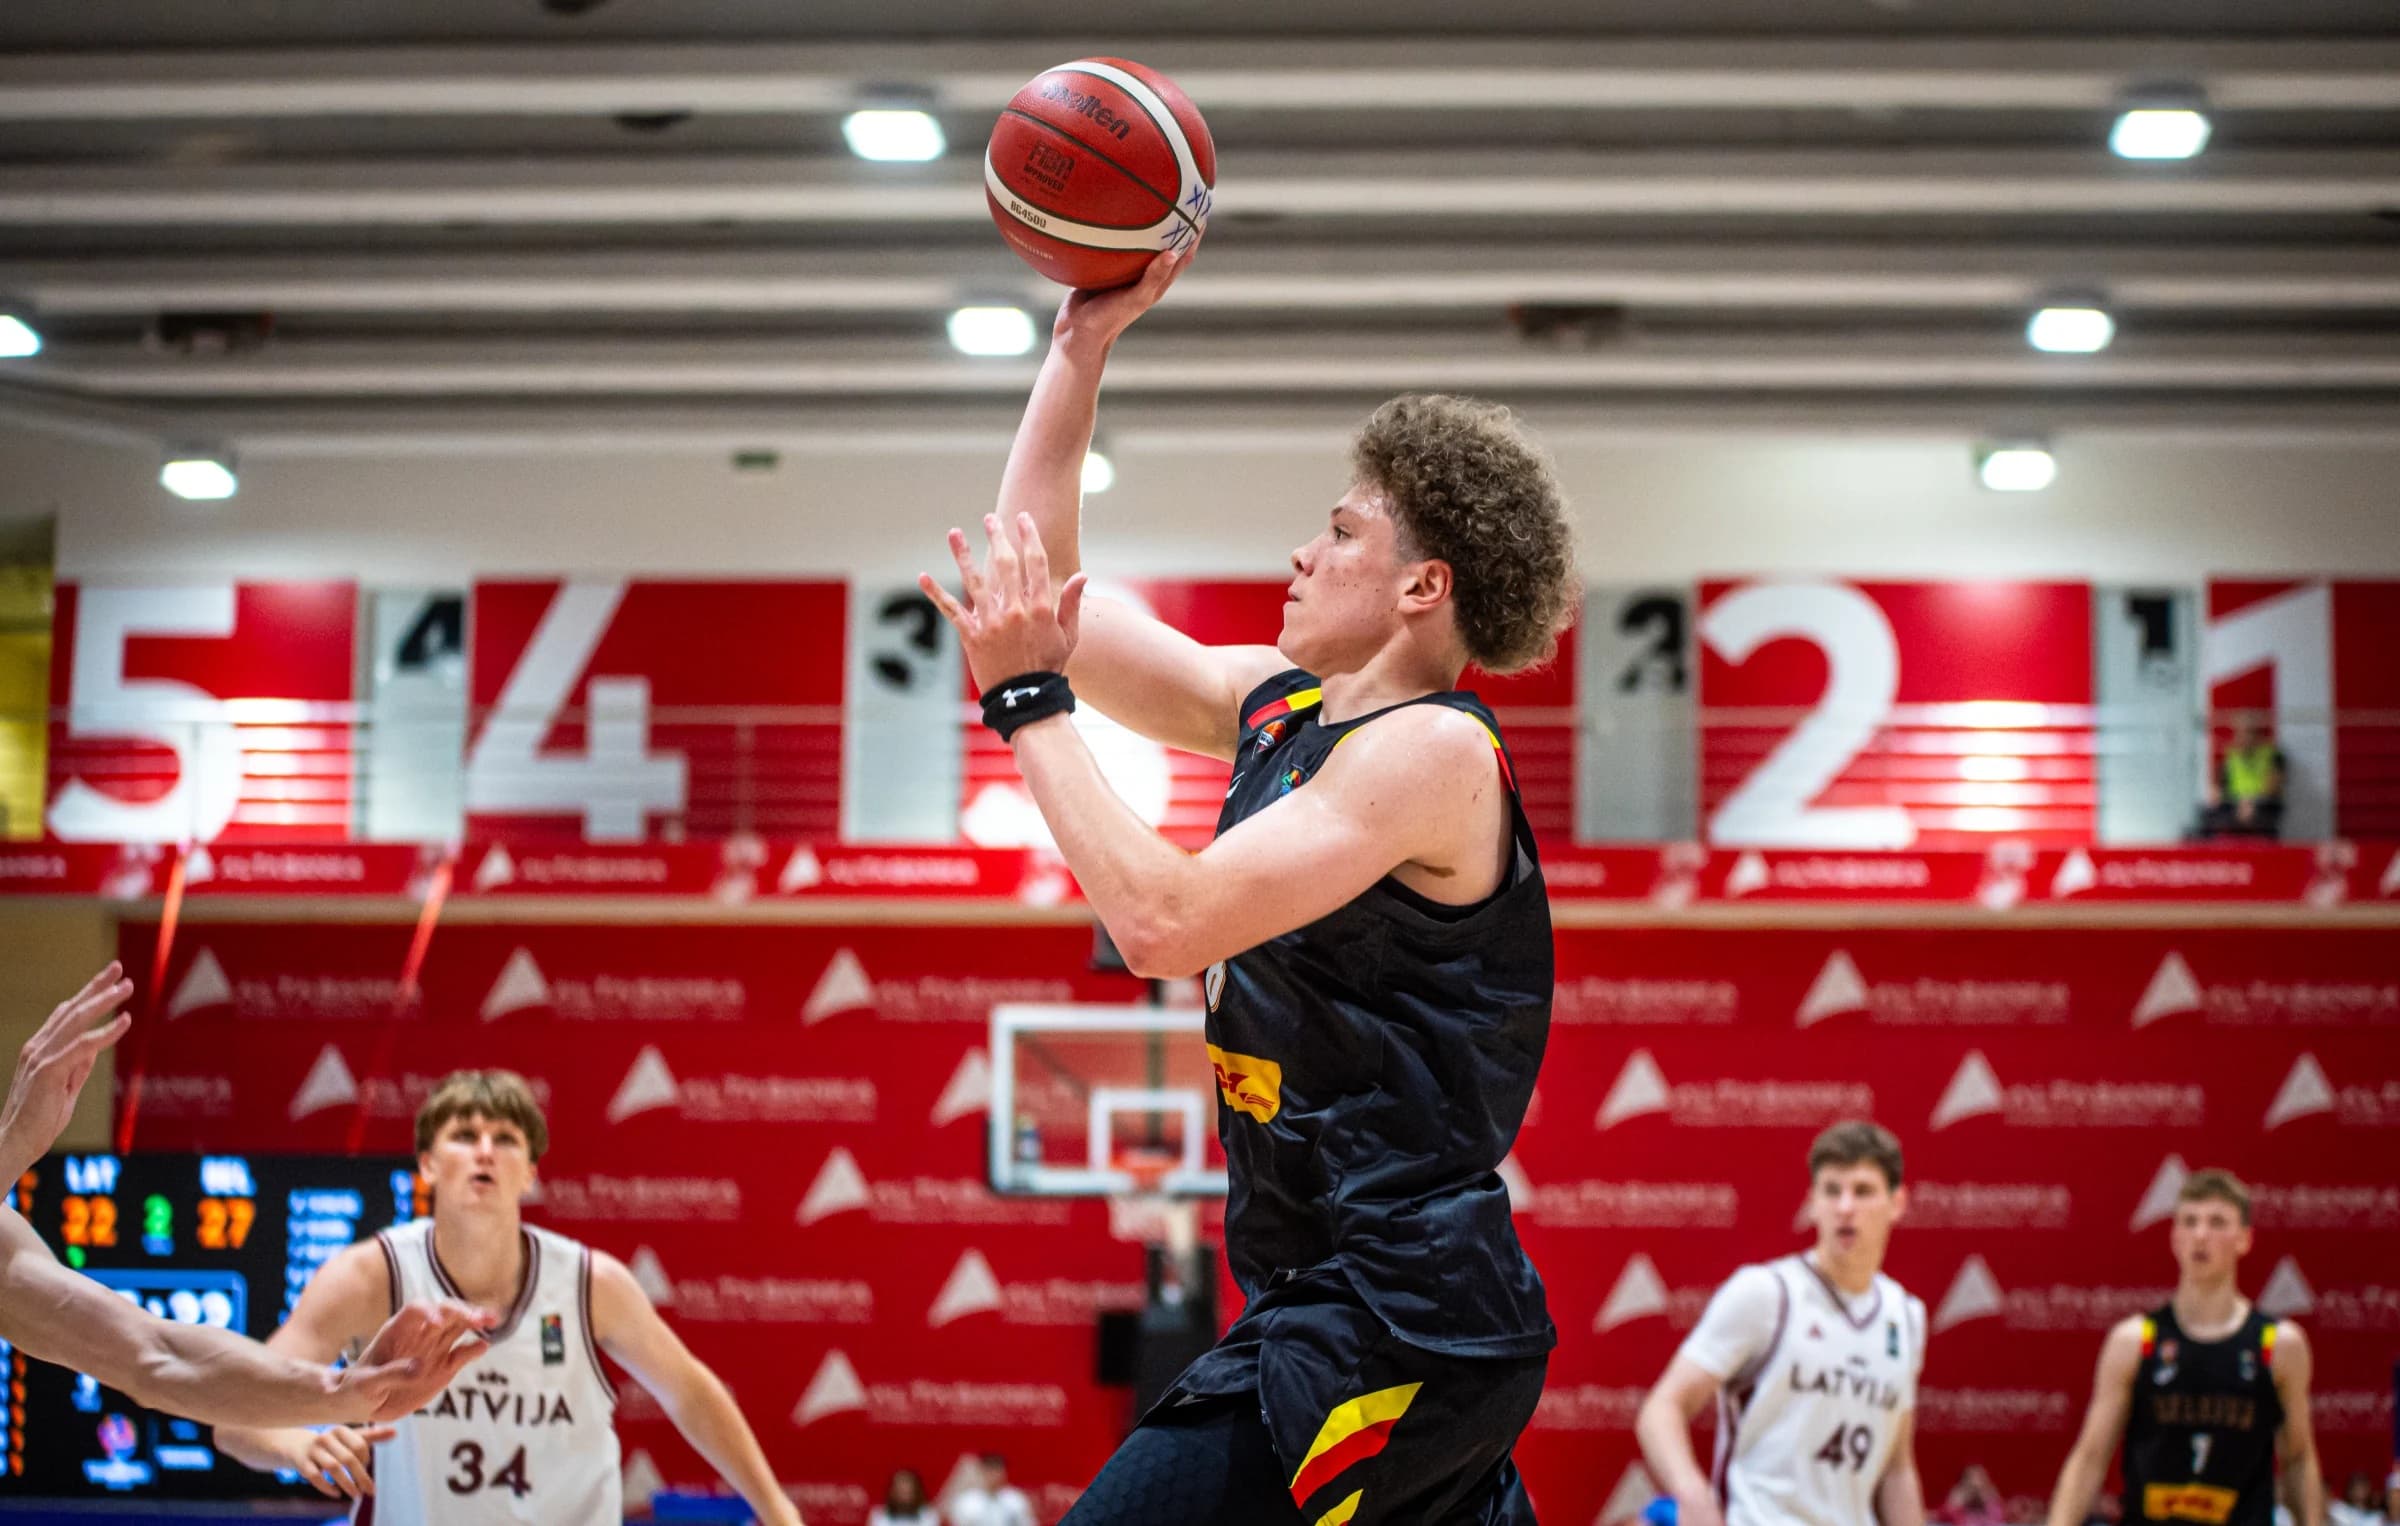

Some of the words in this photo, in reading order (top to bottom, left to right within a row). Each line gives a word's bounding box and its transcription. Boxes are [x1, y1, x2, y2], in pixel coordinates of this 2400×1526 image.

[1010, 200, 1047, 229] BG4500
[49, 586, 240, 844] 5
[467, 576, 686, 843] 4
[1699, 584, 1916, 849] 2
[2203, 581, 2332, 838] 1
[61, 1195, 117, 1247] 22
[197, 1197, 256, 1248] 27
[447, 1439, 532, 1499] 34
[1814, 1421, 1873, 1473] 49
